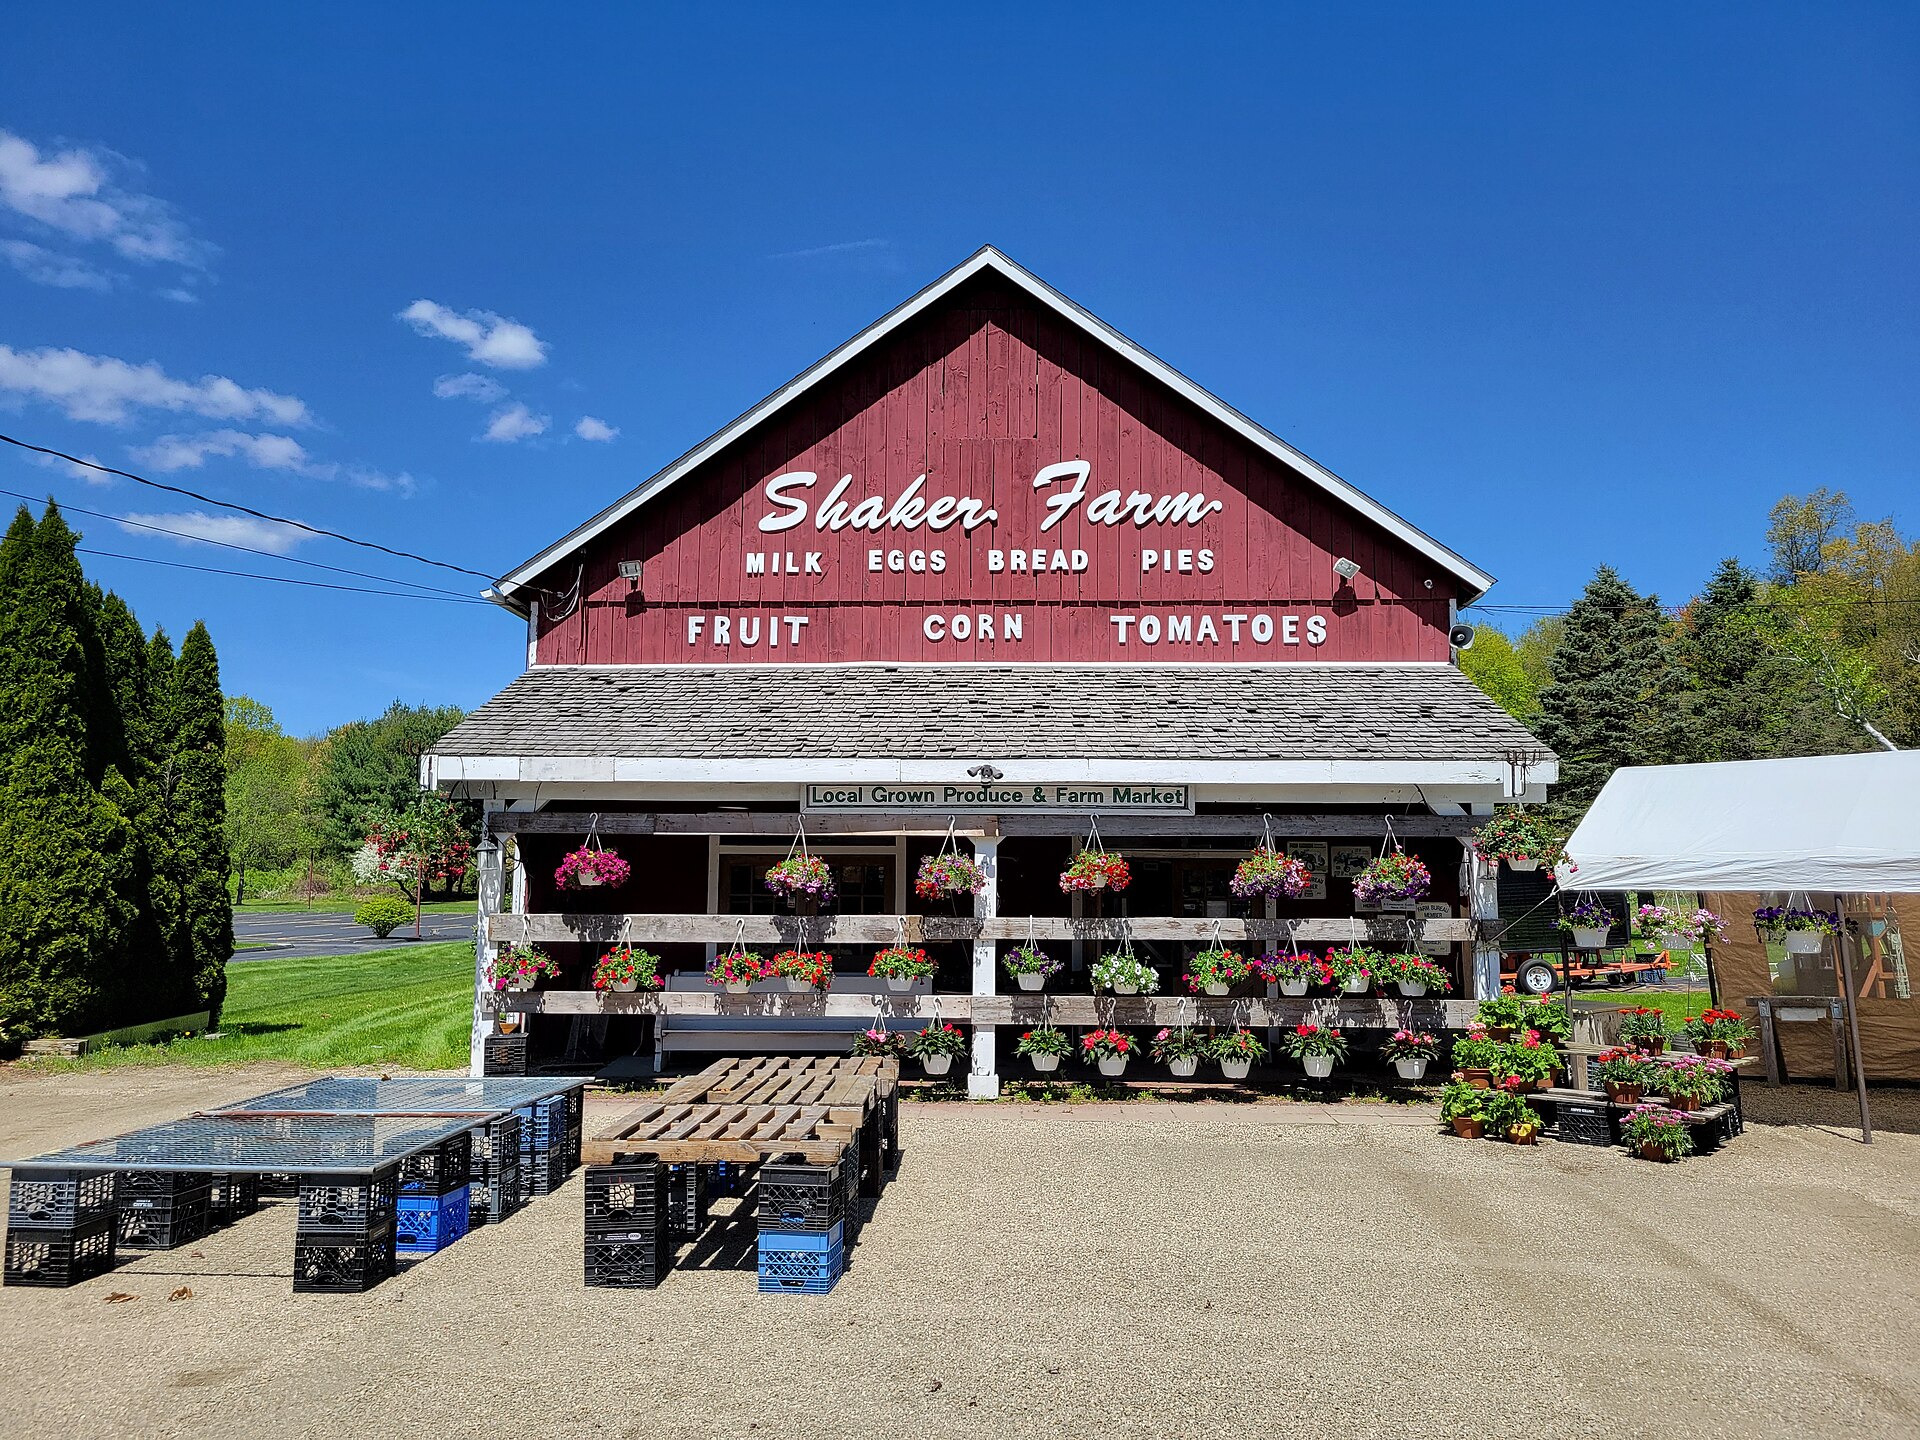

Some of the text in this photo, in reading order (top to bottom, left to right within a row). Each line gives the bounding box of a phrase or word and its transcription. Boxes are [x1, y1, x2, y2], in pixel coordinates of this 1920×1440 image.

[758, 459, 1223, 535] Shaker Farm
[746, 549, 1215, 574] MILK EGGS BREAD PIES
[688, 613, 1327, 646] FRUIT CORN TOMATOES
[812, 786, 1183, 804] Local Grown Produce & Farm Market
